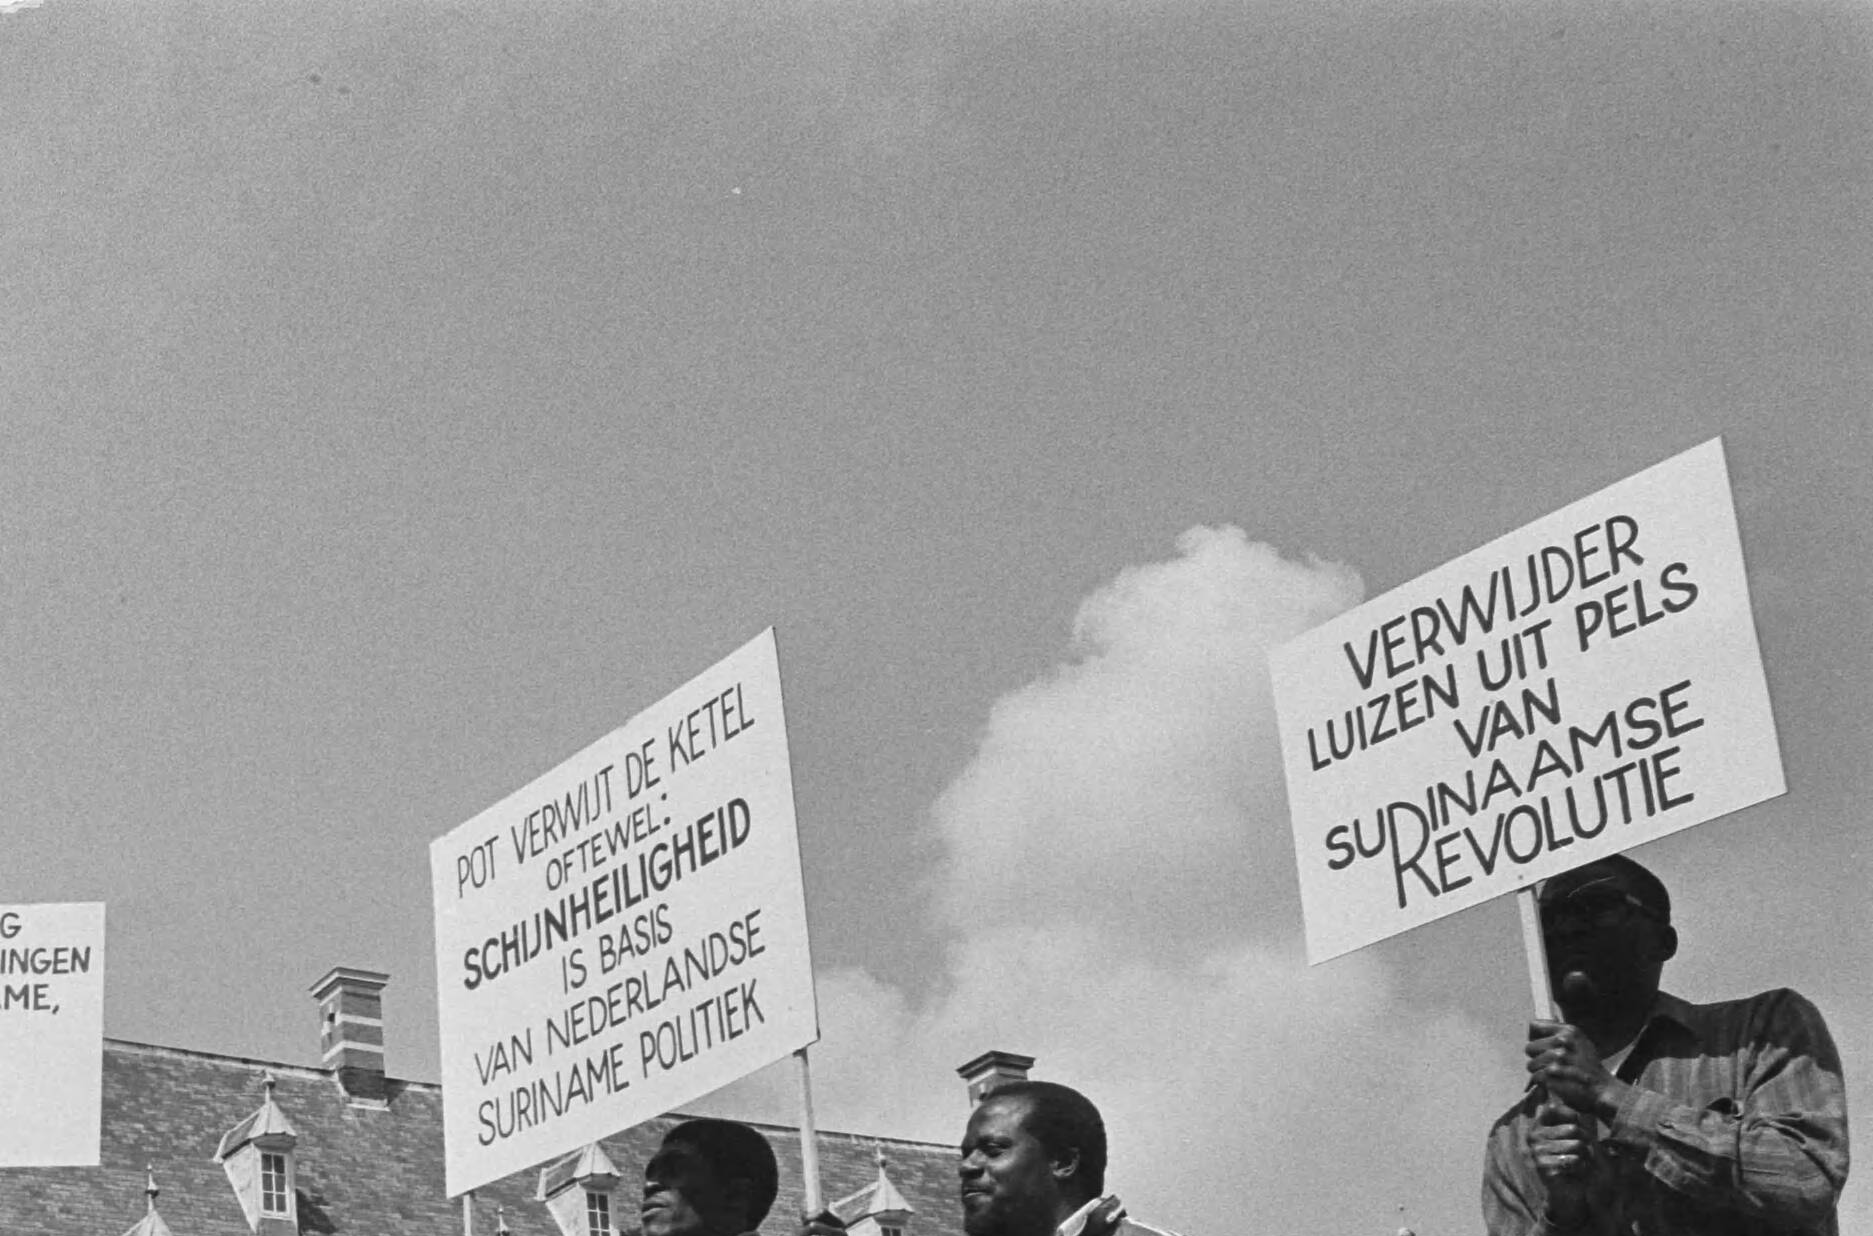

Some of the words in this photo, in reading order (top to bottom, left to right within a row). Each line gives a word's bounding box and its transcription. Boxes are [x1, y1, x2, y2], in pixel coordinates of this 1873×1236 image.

[1306, 663, 1460, 772] LUIZEN
[1476, 618, 1552, 692] UIT
[1575, 562, 1700, 652] PELS
[1343, 514, 1645, 690] VERWIJDER
[456, 835, 499, 899] POT
[510, 764, 615, 865] VERWIJT
[624, 737, 661, 800] DE
[668, 682, 756, 774] KETEL
[1454, 677, 1562, 758] VAN
[463, 797, 751, 990] SCHIJNHEILIGHEID
[545, 792, 672, 892] OFTEWEL:
[474, 1026, 533, 1086] VAN
[546, 908, 767, 1056] NEDERLANDSE
[561, 948, 588, 995] IS
[598, 903, 674, 975] BASIS
[477, 1042, 630, 1147] SURINAME
[639, 977, 766, 1080] POLITIEK
